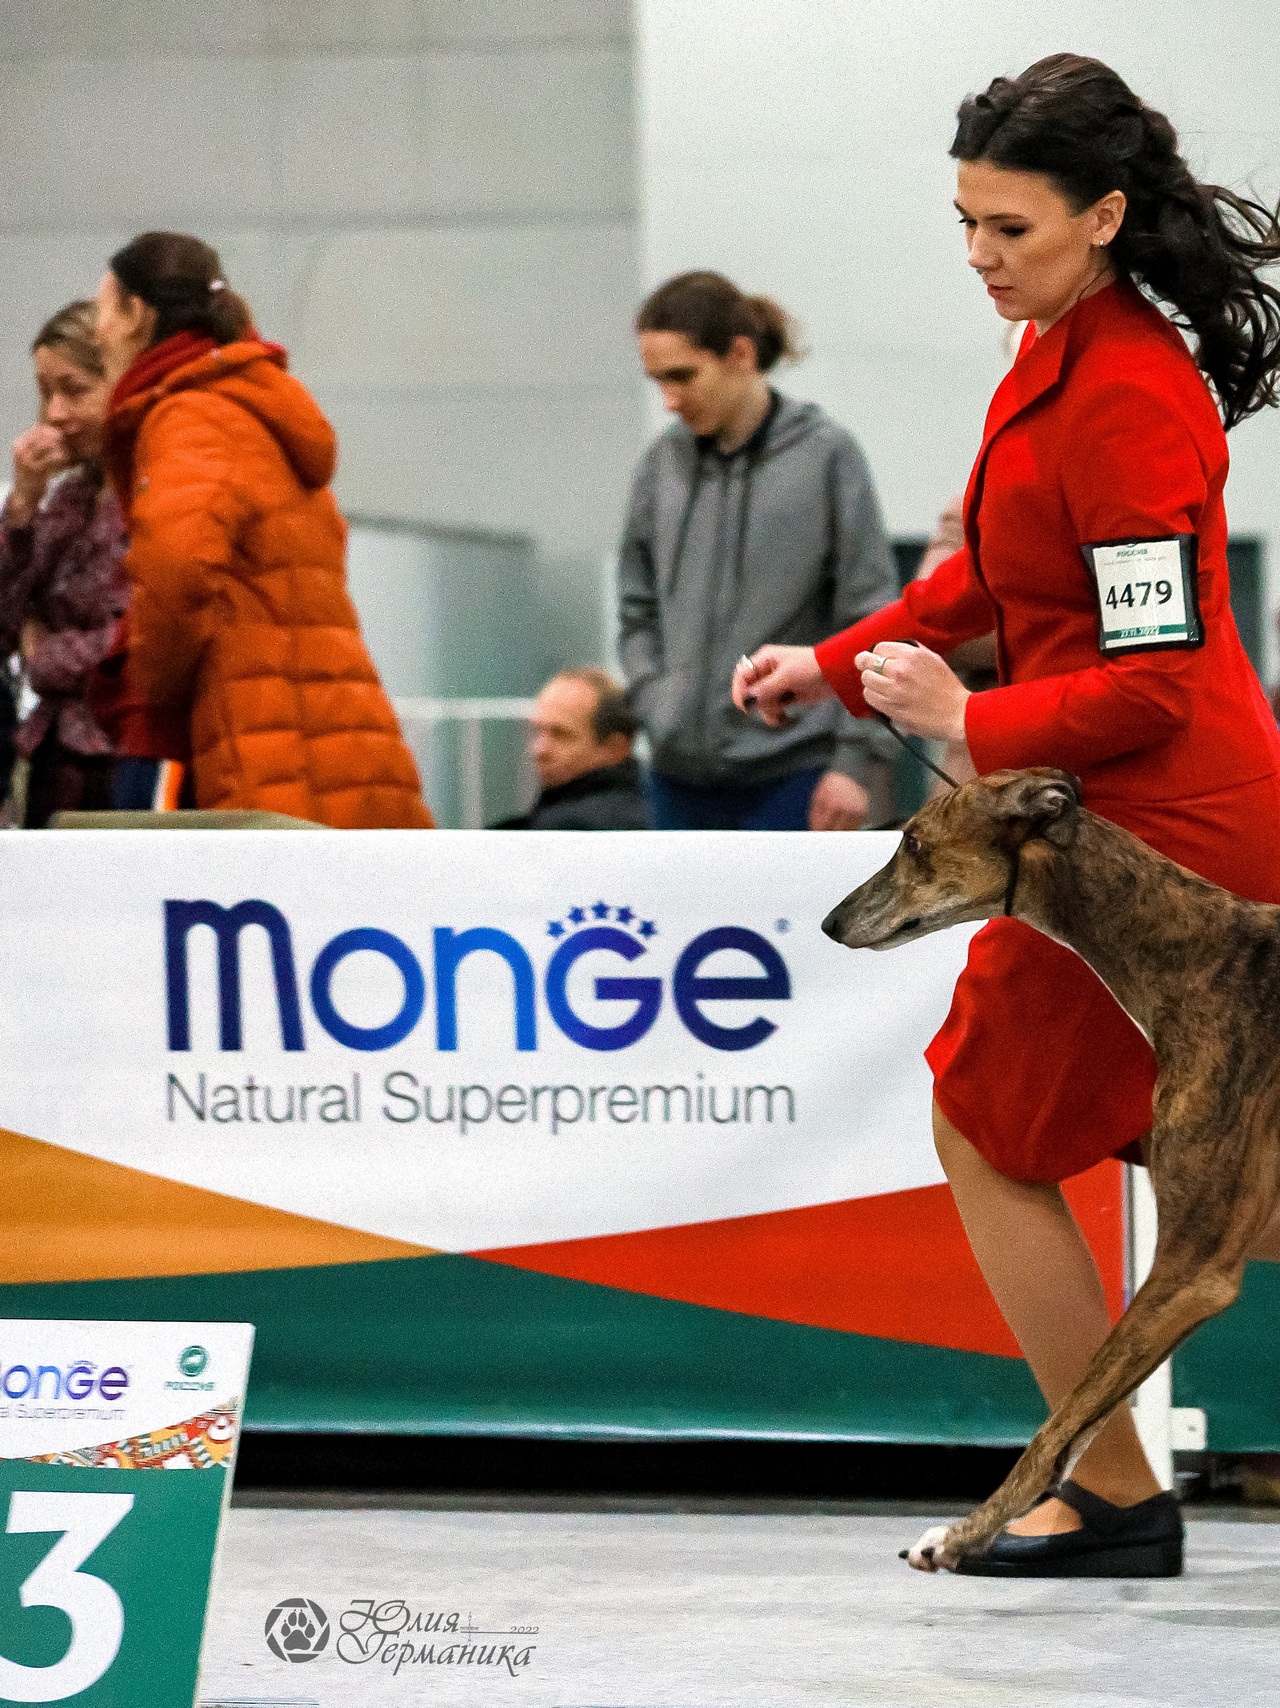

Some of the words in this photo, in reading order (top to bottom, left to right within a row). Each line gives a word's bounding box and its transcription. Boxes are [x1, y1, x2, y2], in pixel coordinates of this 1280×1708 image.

[1106, 580, 1172, 609] 4479
[167, 1073, 360, 1125] Natural
[383, 1072, 796, 1136] Superpremium
[0, 1491, 134, 1703] 3
